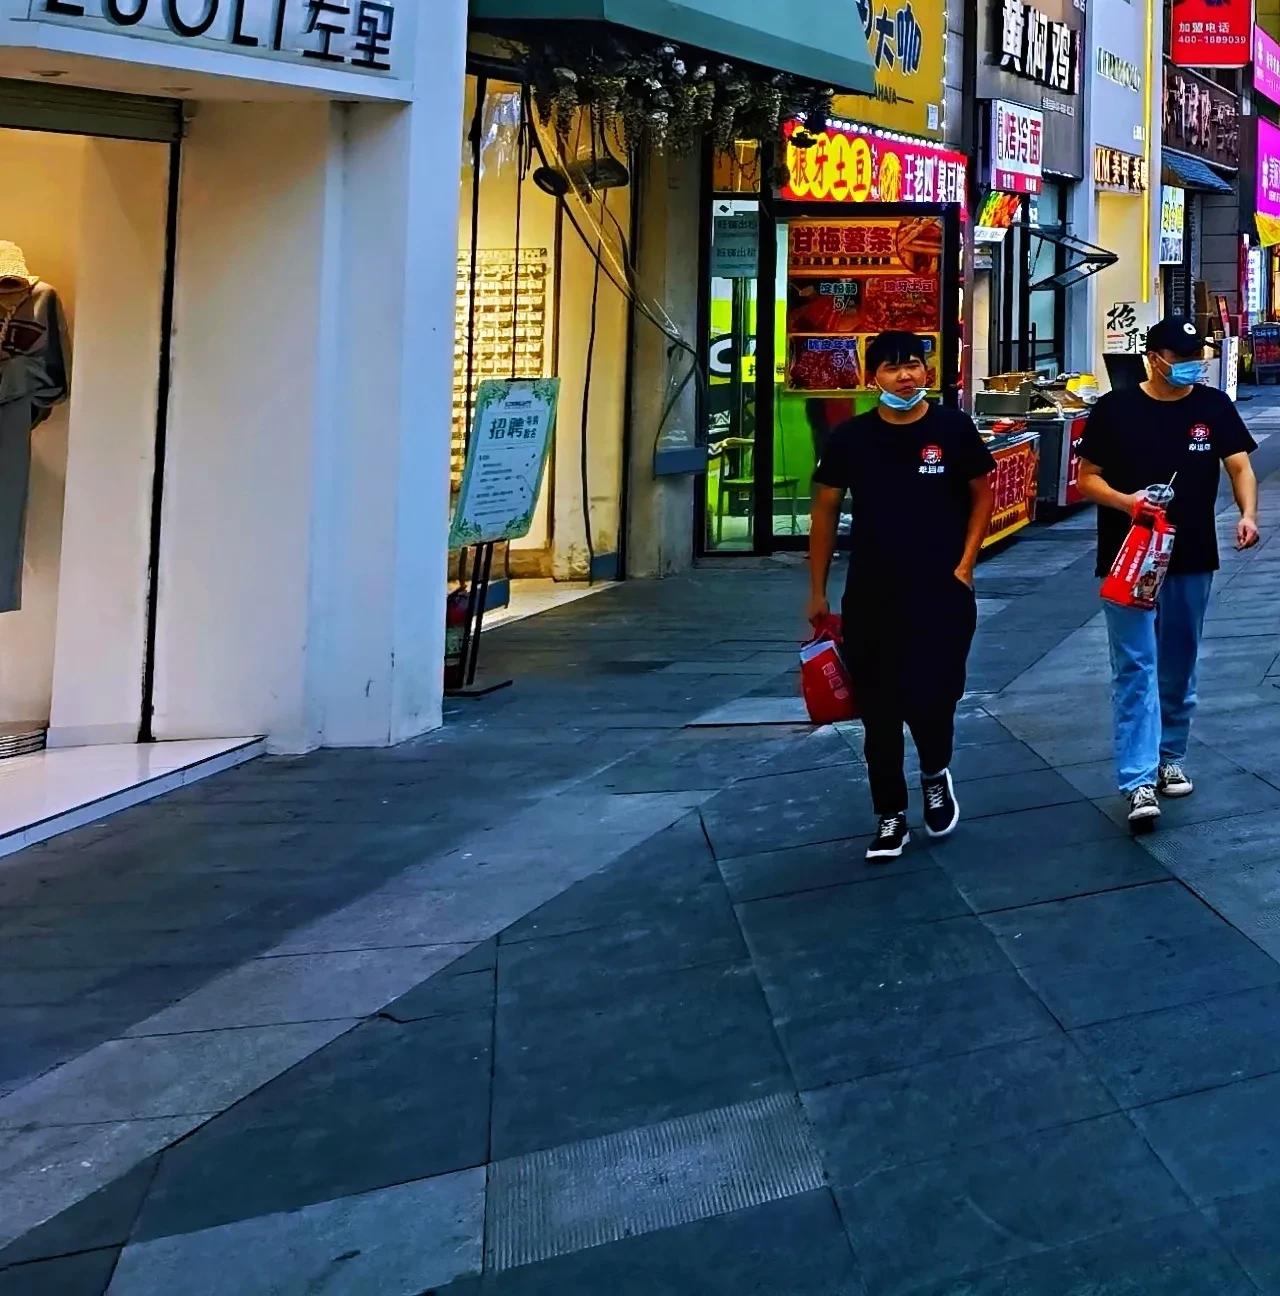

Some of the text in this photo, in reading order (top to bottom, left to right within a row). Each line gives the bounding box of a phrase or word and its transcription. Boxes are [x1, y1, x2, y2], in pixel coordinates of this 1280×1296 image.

[1178, 21, 1231, 34] 加盟电话
[792, 226, 893, 254] 甘梅薯条
[489, 416, 524, 440] 招聘
